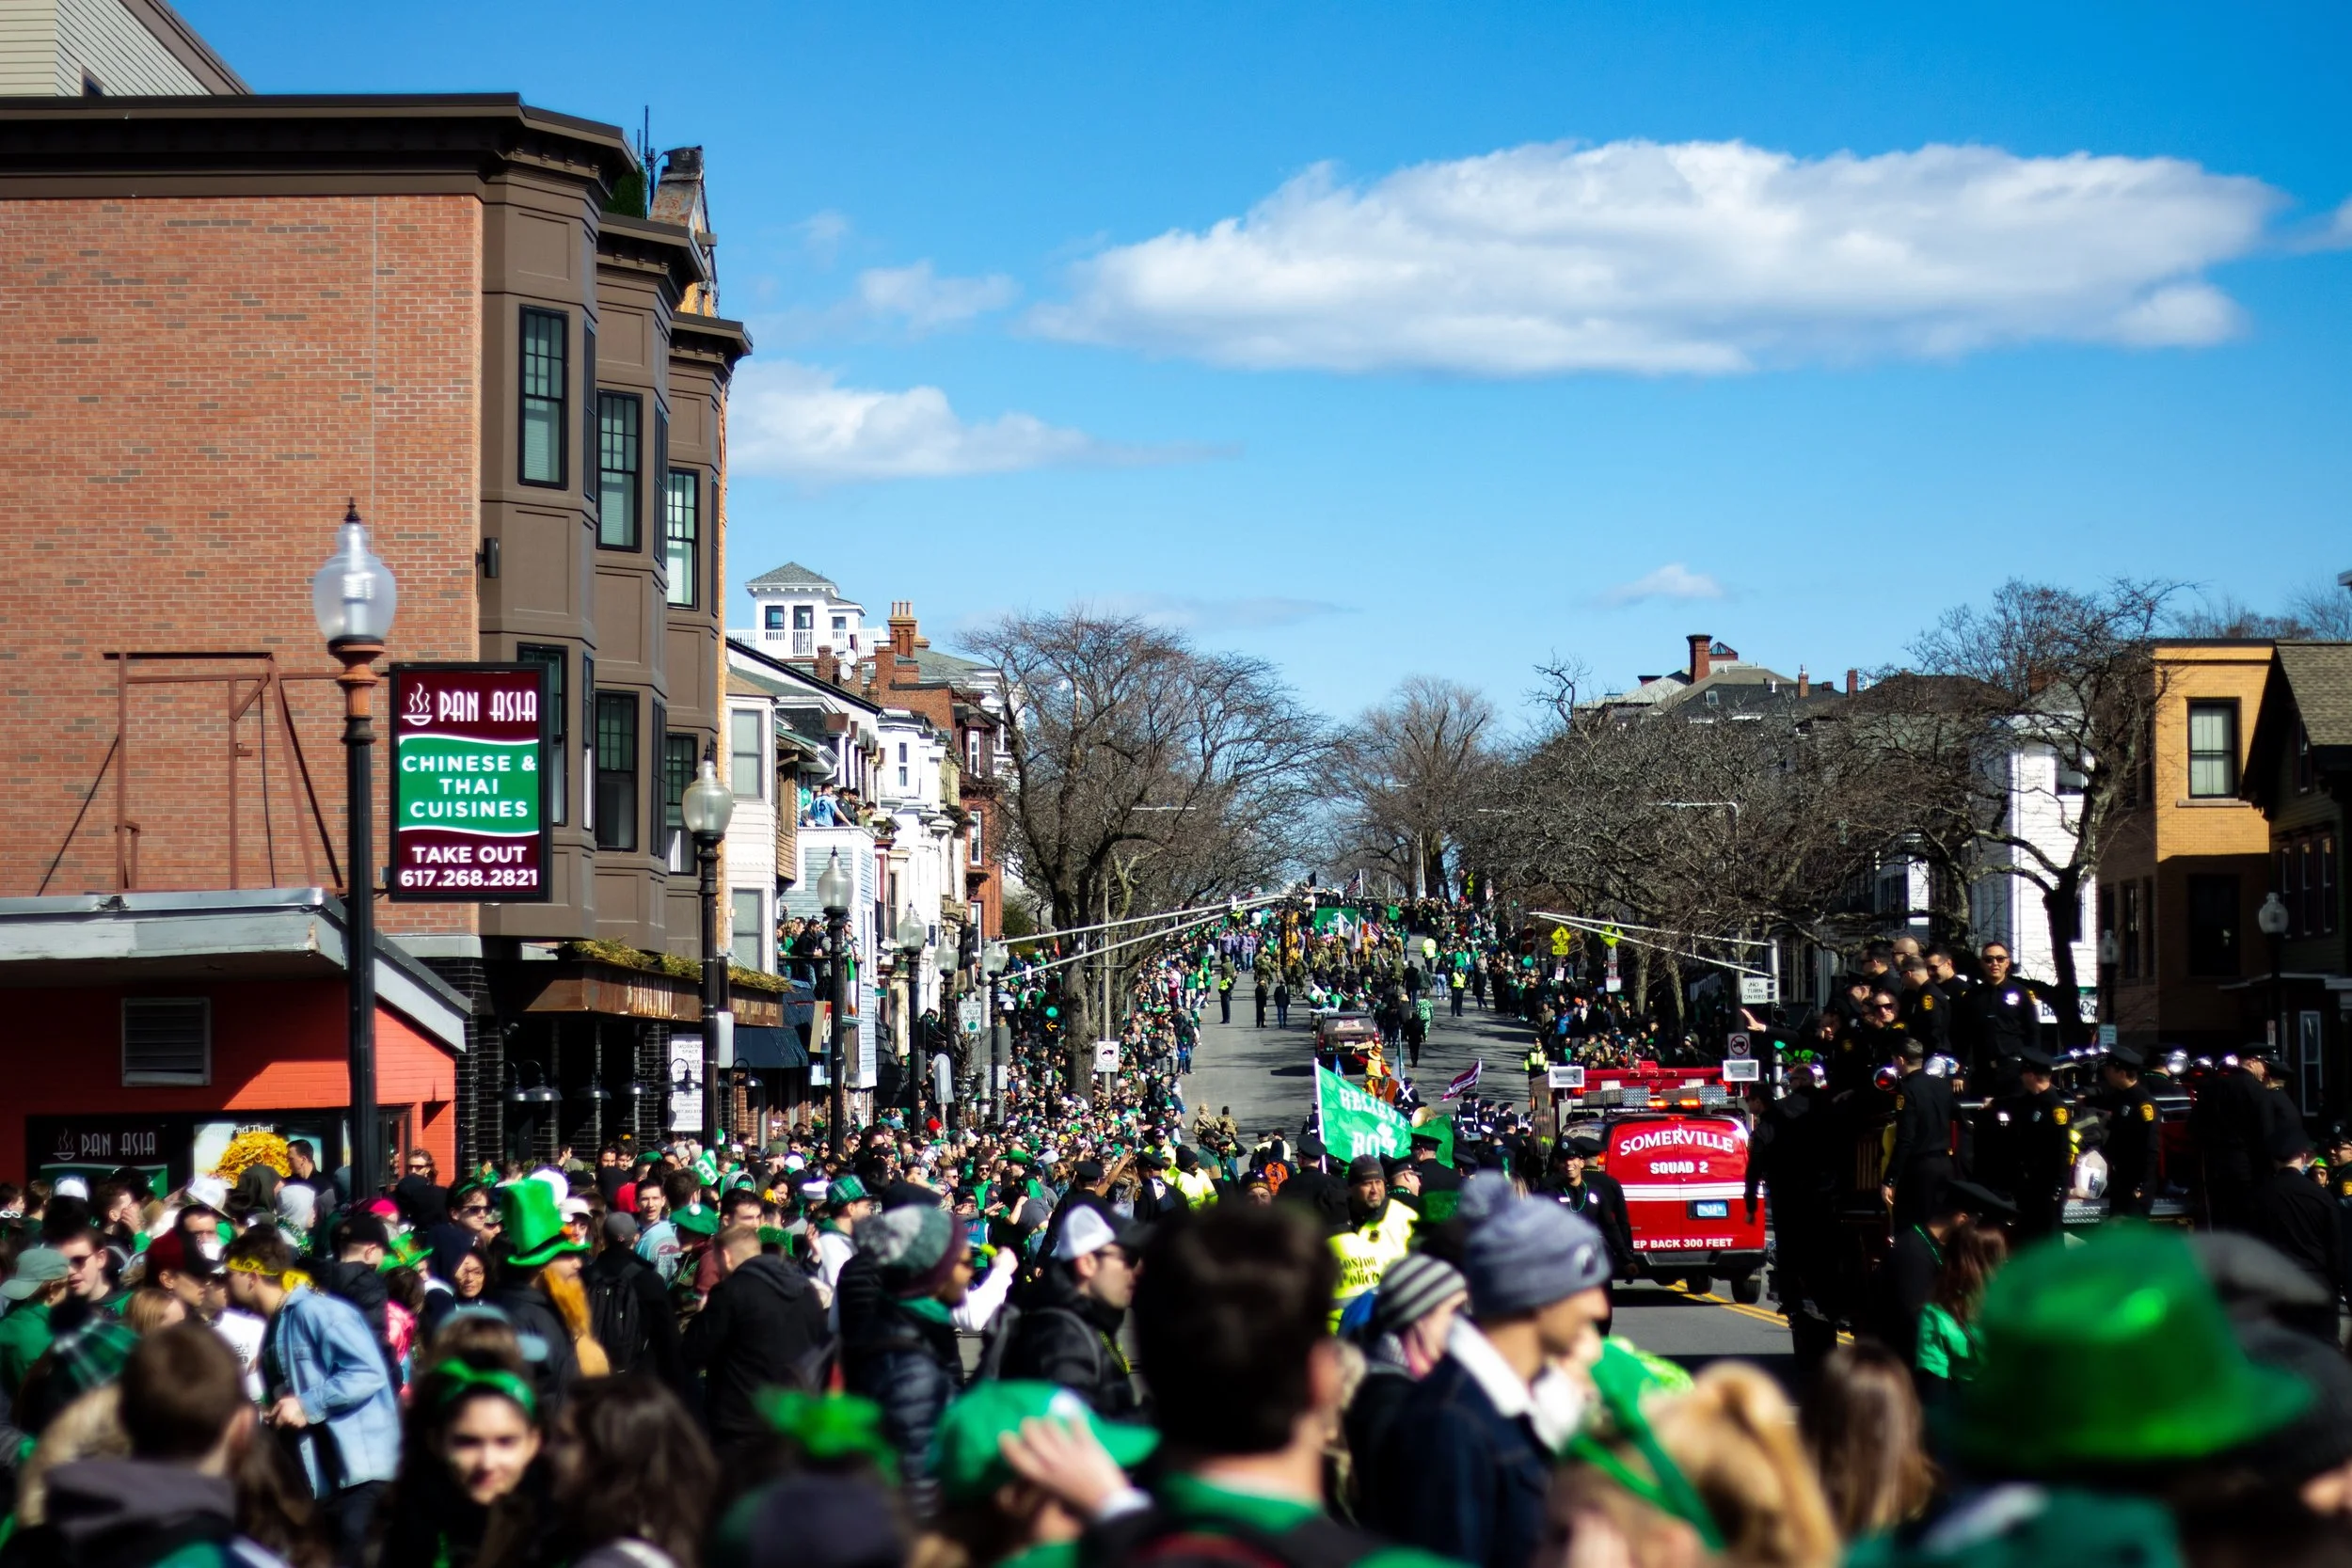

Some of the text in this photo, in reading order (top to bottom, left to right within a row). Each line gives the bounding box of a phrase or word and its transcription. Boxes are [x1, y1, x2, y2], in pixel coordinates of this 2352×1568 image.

[438, 690, 537, 722] PAN ASIA
[402, 755, 536, 772] CHINESE &
[439, 779, 499, 795] THAI
[410, 800, 528, 817] CUISINES
[412, 847, 527, 863] TAKE OUT
[400, 869, 537, 886] 617.268.2821
[230, 1125, 249, 1134] Pad
[250, 1124, 274, 1133] Thai
[81, 1132, 156, 1157] PAN ASIA
[1620, 1130, 1734, 1156] SOMERVILLE
[1649, 1161, 1709, 1175] SQUAD 2
[1632, 1237, 1734, 1250] EP BACK 300 FEET
[1340, 1257, 1376, 1270] oston
